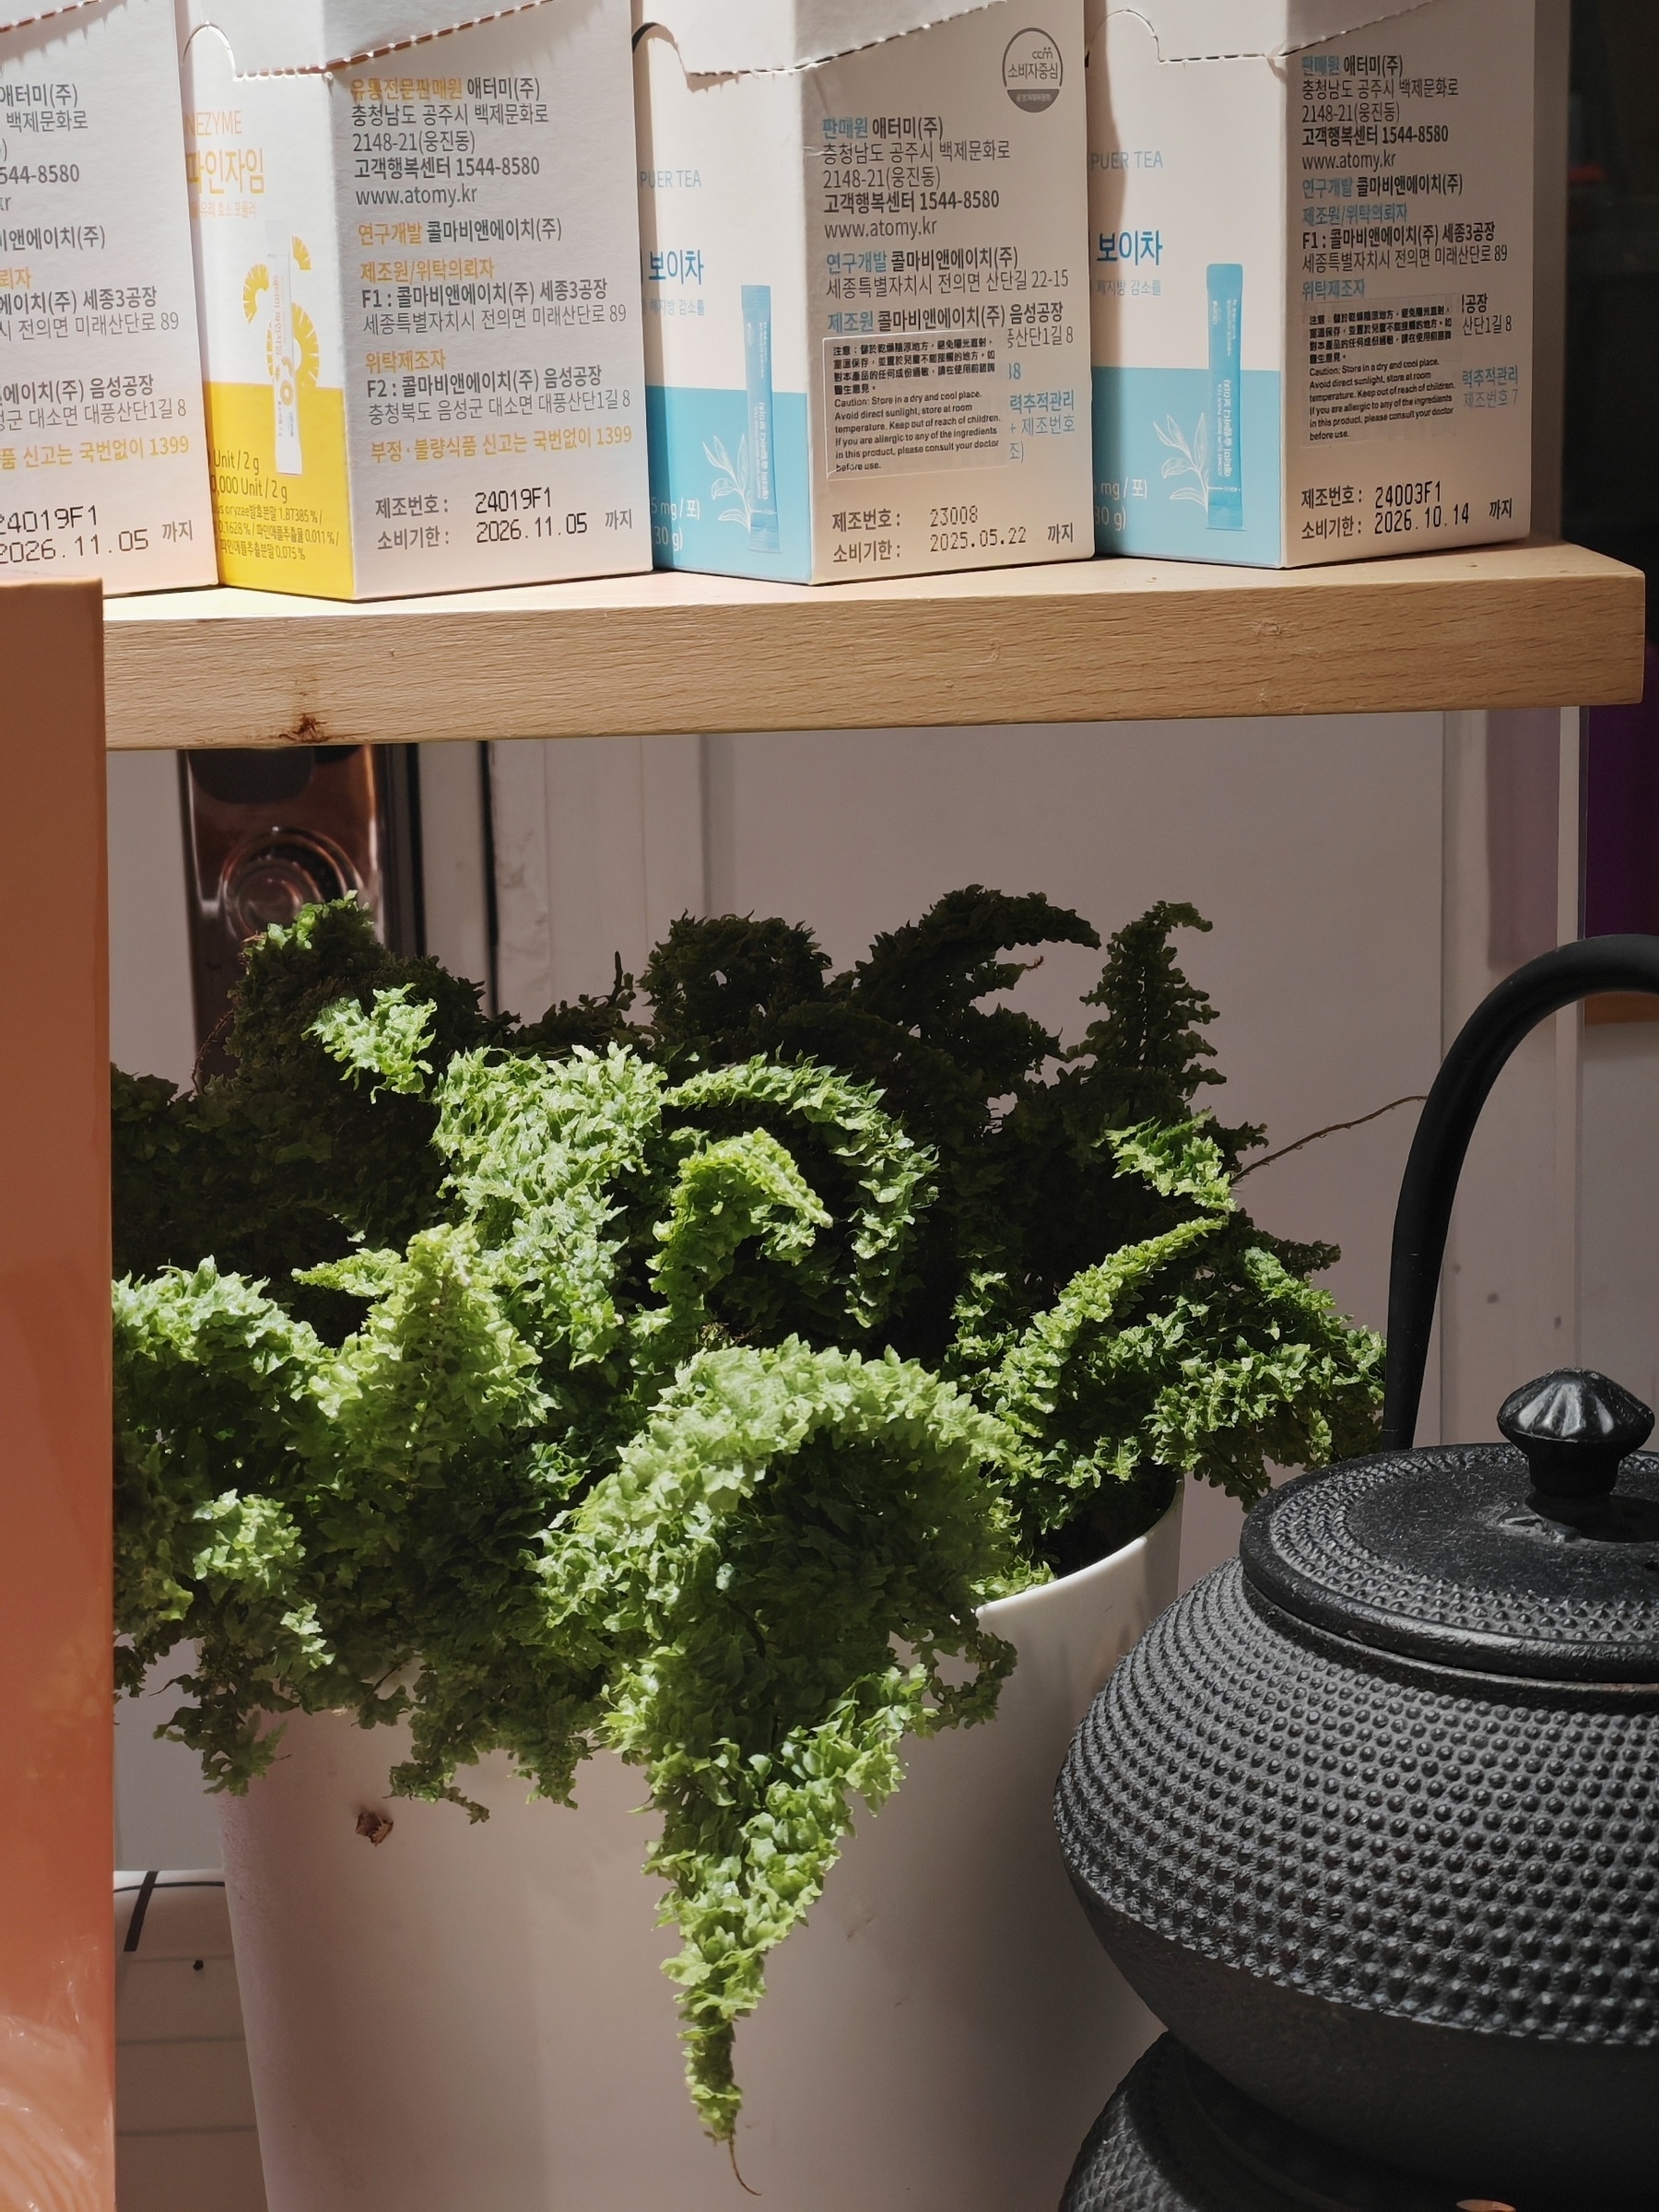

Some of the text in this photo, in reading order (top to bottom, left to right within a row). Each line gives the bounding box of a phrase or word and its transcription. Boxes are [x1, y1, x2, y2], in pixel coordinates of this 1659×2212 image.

[1007, 62, 1058, 80] 소비자중심
[1344, 55, 1404, 77] 애터미(주)
[467, 76, 540, 101] 애터미(주)
[1302, 77, 1459, 100] 충청남도 공주시 백제문화로
[6, 110, 88, 133] 백제문화로
[352, 102, 549, 127] 충청남도 공주시 백제문화로
[1302, 101, 1400, 124] 2148-21(웅진동)
[873, 116, 943, 140] 애터미(주)
[1302, 124, 1449, 147] 고객행복센터 1544-8580
[352, 129, 476, 155] 2148-21(웅진동)
[822, 139, 1010, 165] 충청남도 공주시 백제문화로
[185, 147, 265, 194] 파인자임
[354, 156, 540, 181] 고객행복센터 1544-8580
[1091, 150, 1163, 170] PUER TEA
[1302, 149, 1396, 173] www.atomy.kr
[641, 169, 701, 188] PUER TEA
[823, 166, 940, 190] 2148-21(웅진동)
[1302, 173, 1463, 199] 연구개발 콜마비앤에이치(주)
[356, 183, 477, 208] www.atomy.kr
[824, 190, 999, 214] 고객행복센터 1544-8580
[359, 217, 562, 247] 연구개발 콜마비앤에이치(주)
[824, 216, 937, 241] www.atomy.kr
[1330, 221, 1496, 249] 콜마비앤에이치(주) 세종3공장
[1097, 229, 1163, 266] 보이차
[1302, 244, 1508, 274] 세종특별자치시 전의면 미래산단로 89
[359, 256, 495, 285] 제조원/위탁의뢰자
[649, 249, 705, 286] 보이차
[826, 246, 1018, 275] 연구개발 콜마비앤에이치(주)
[396, 277, 608, 308] 콜마비앤에이치(주) 세종3공장
[826, 269, 1069, 300] 세종특별자치시 전의면 산단길 22-15
[83, 285, 157, 311] 세종3공장
[18, 311, 179, 341] 전의면 미래산단로 89
[363, 303, 628, 336] 세종특별자치시 전의면 미래산단로 89
[828, 301, 1064, 334] 제조원 콜마비앤에이치(주) 음성공장
[1463, 314, 1512, 335] 산단1길 8
[1065, 325, 1074, 344] 8
[365, 348, 446, 374] 위탁제조자
[89, 373, 154, 399] 음성공장
[401, 364, 602, 398] 콜마비앤에이치(주) 음성공장
[369, 389, 631, 426] 충청북도 음성군 대소면 대풍산단1길 8
[835, 391, 957, 407] Caution: Store dry and cool
[29, 398, 187, 429] 대소면 대풍산단1길 8
[835, 404, 972, 421] Avoid direct store room
[889, 417, 957, 430] Keep reach
[843, 427, 997, 449] you are allergic any the ingredients
[1021, 415, 1075, 436] 제조번호
[24, 435, 190, 468] 신고는 국번없이 1399
[482, 430, 527, 456] 신고는
[533, 427, 592, 452] 국번없이
[596, 425, 632, 445] 1399
[845, 440, 999, 459] this please consult your doctor
[241, 478, 264, 500] Unit
[475, 487, 552, 514] 24019F1
[1101, 482, 1120, 500] mg
[1375, 480, 1441, 509] 24003F1
[605, 508, 632, 531] 까지
[930, 505, 979, 527] 23008
[1489, 498, 1513, 520] 까지
[162, 519, 194, 543] 까지
[1048, 523, 1074, 544] 까지
